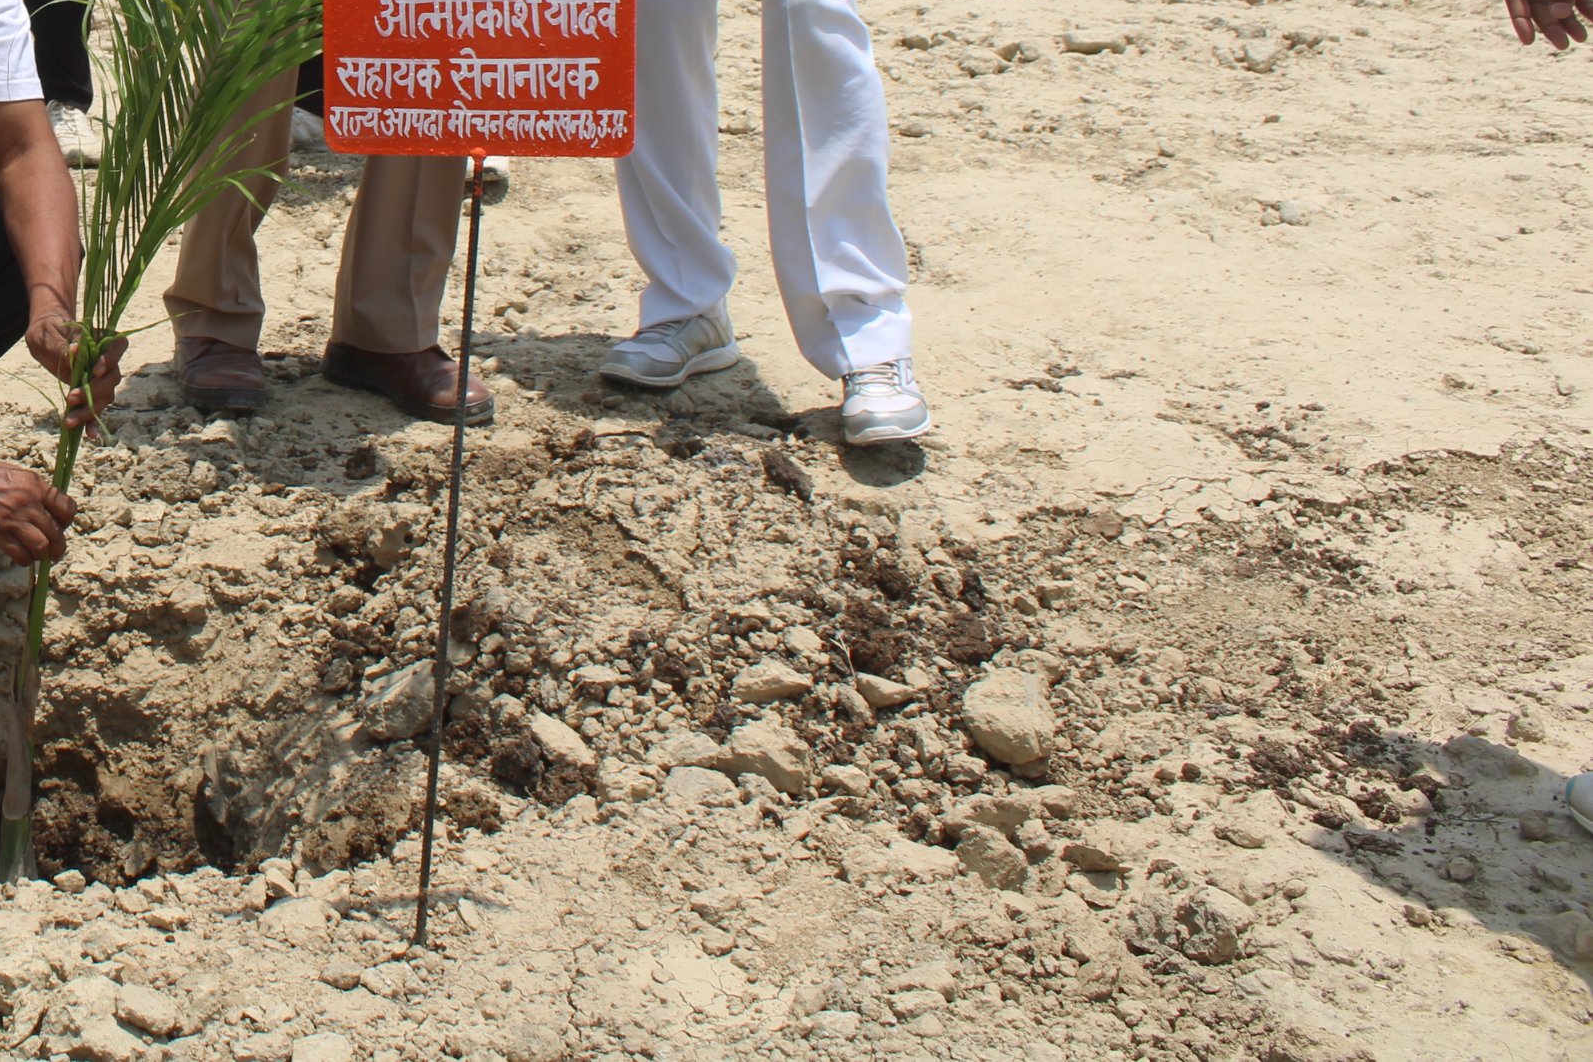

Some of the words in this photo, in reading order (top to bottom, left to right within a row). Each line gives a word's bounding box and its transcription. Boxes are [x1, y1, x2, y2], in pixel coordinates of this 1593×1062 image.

[336, 57, 442, 99] सहायक
[449, 47, 601, 101] सेनानायक
[329, 106, 382, 137] राज्य
[380, 107, 448, 141] आपदा
[447, 100, 508, 140] मोचन
[506, 109, 540, 141] बल
